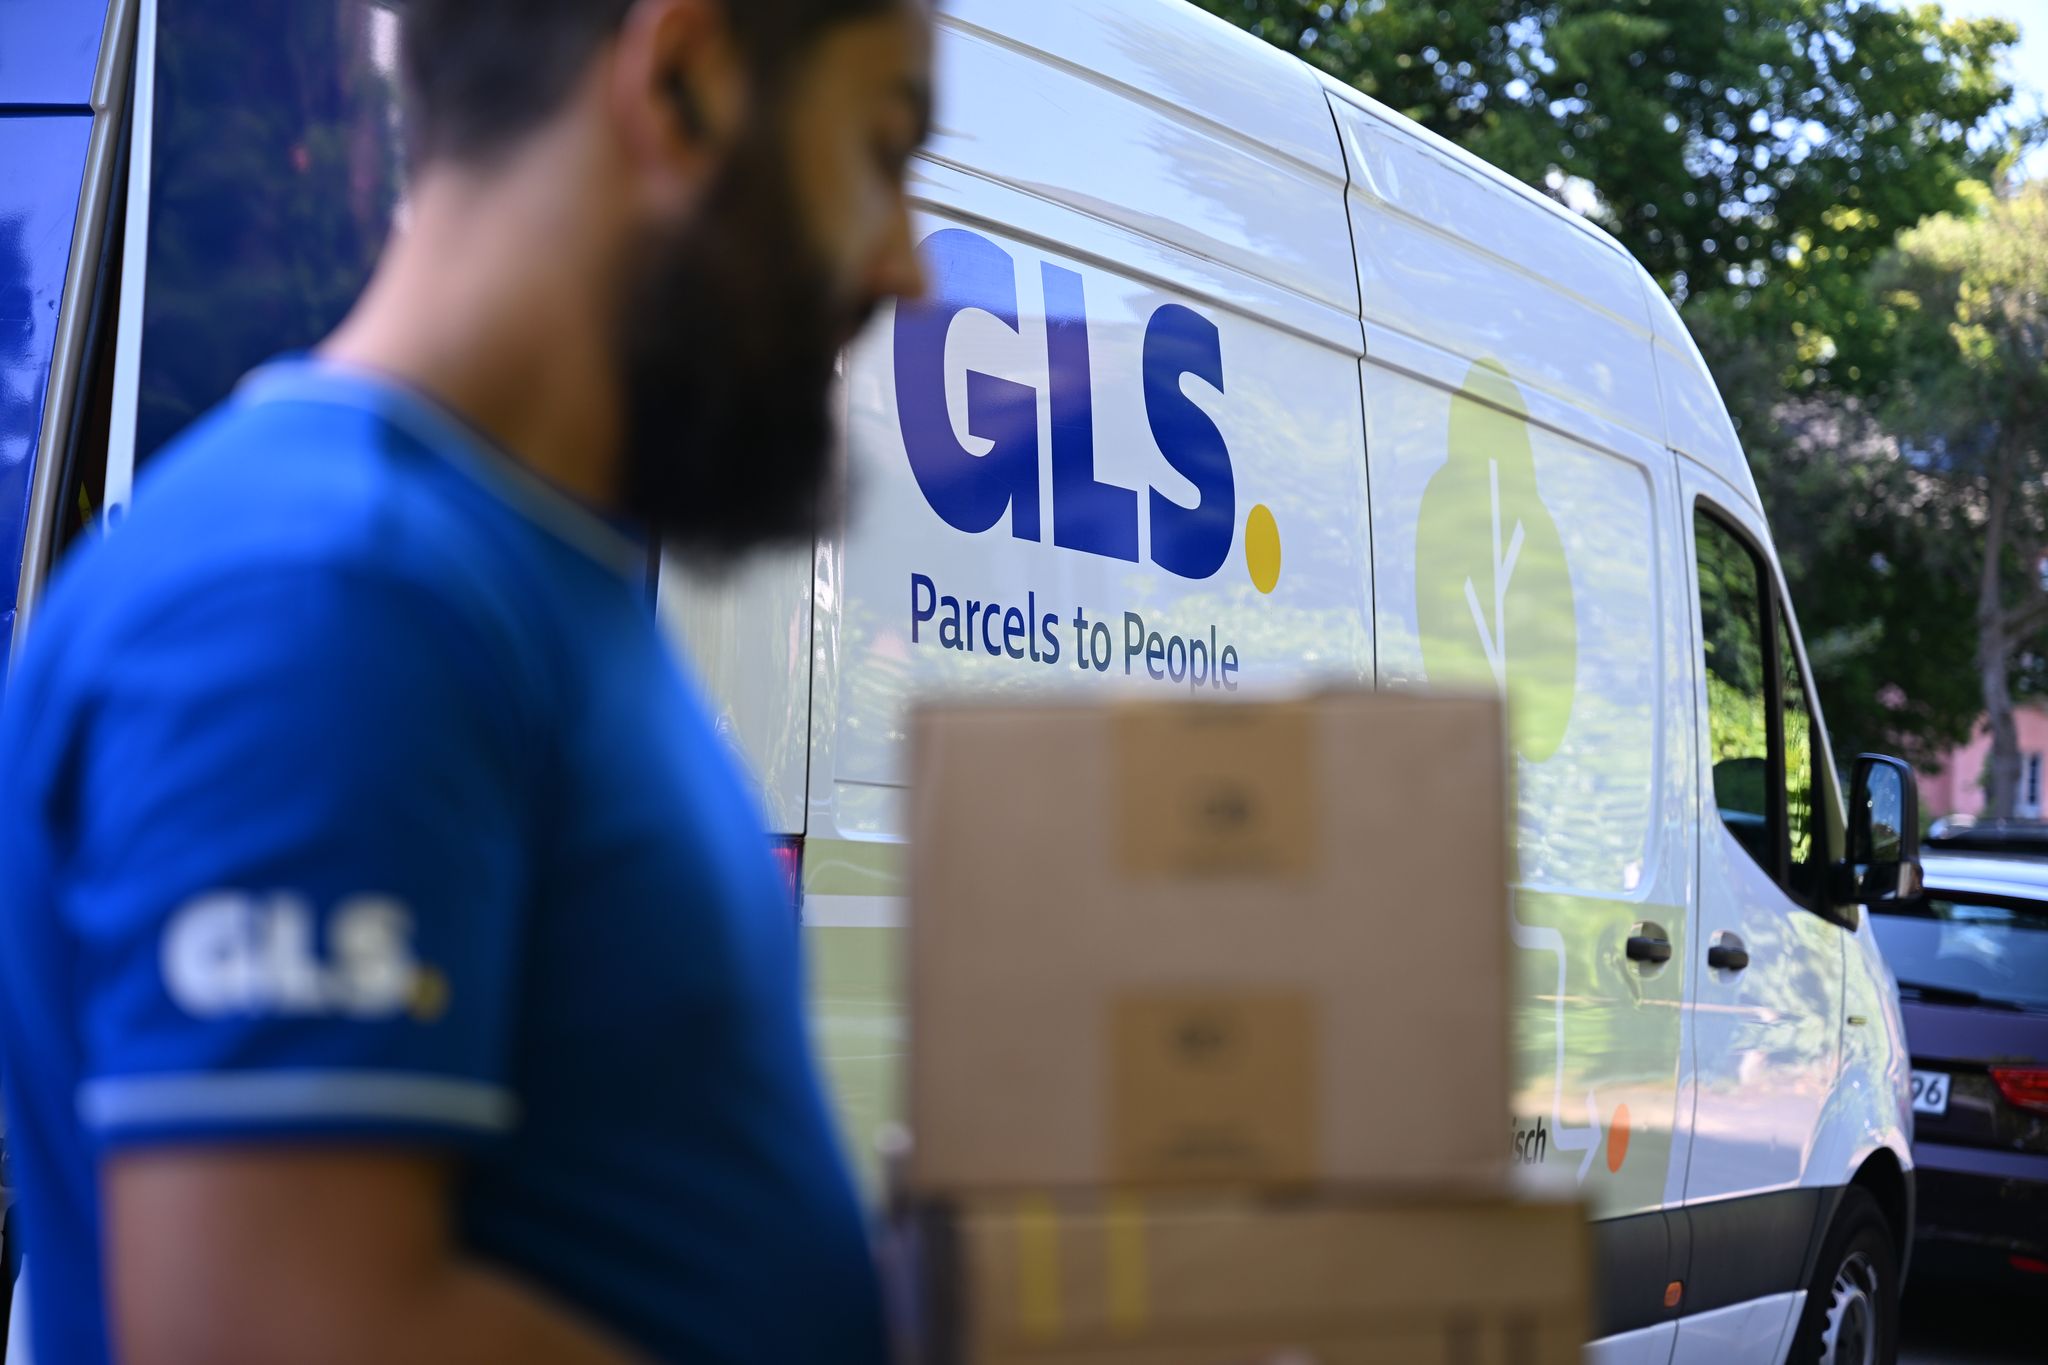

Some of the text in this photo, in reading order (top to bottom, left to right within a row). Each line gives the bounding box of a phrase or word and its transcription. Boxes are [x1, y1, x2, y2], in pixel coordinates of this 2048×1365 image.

[911, 572, 1239, 693] Parcels to People
